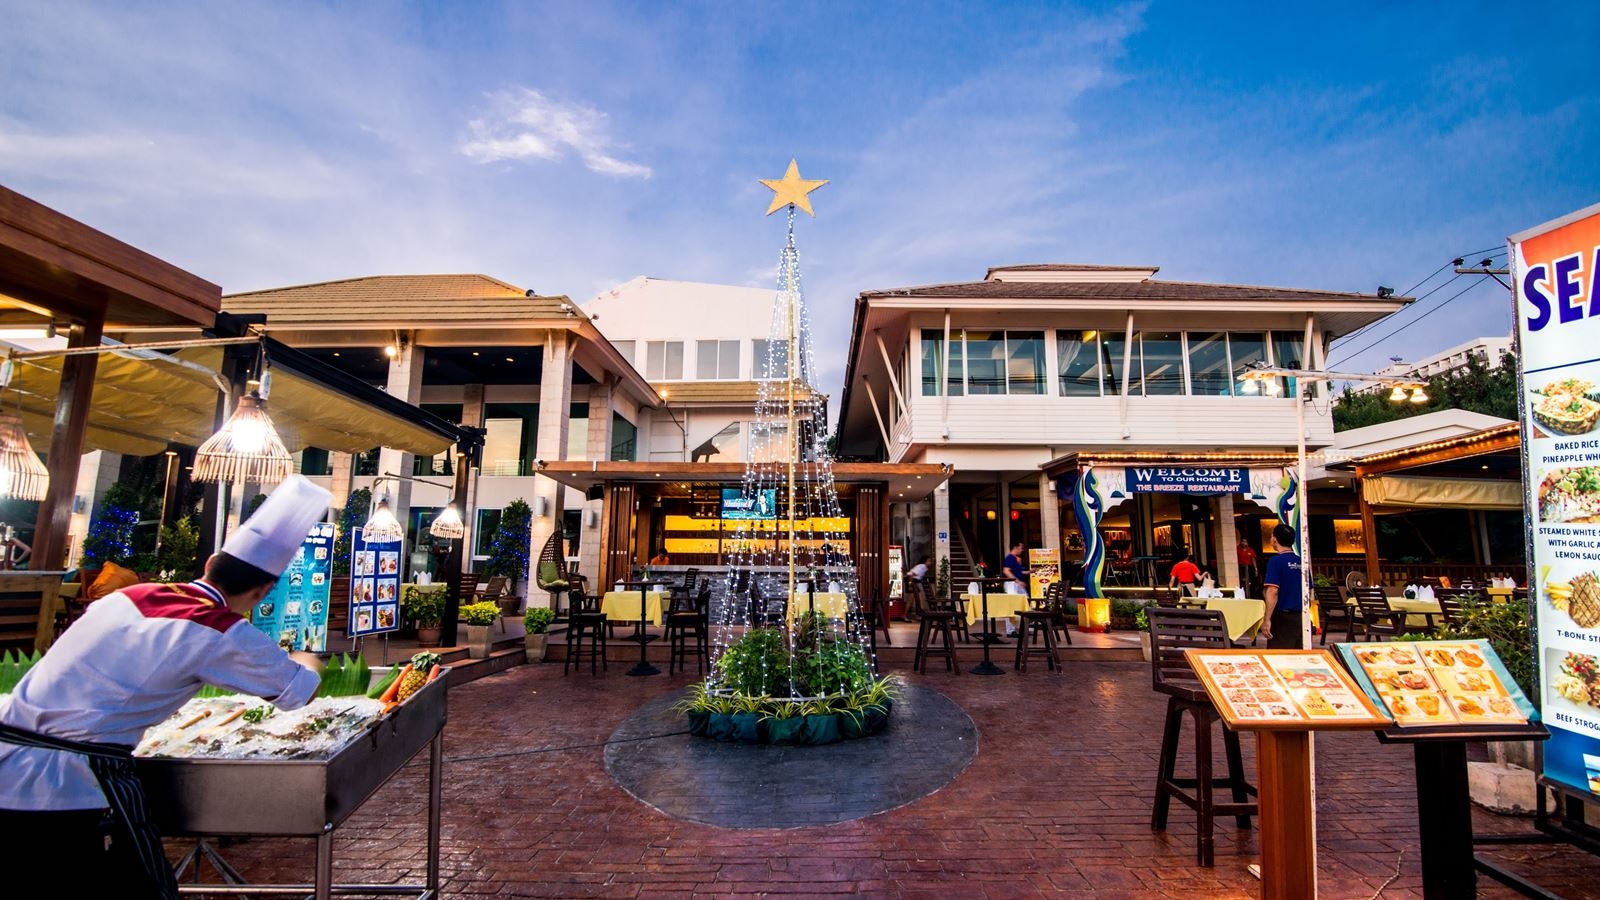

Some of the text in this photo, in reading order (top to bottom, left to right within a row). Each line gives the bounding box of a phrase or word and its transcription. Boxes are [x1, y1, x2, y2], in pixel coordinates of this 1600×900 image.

[1554, 439, 1599, 451] BAKED RICE
[1542, 453, 1583, 463] PINEAPPLE
[1133, 468, 1242, 482] WELCOME
[1187, 484, 1240, 492] RESTAURANT
[1539, 527, 1571, 536] STEAMED
[1572, 528, 1596, 537] WHITE
[1548, 539, 1567, 547] WITH
[1568, 540, 1595, 549] GARLIC
[1555, 551, 1581, 560] LEMON
[1557, 629, 1600, 643] T-BONE ST
[1556, 712, 1573, 723] BEEF
